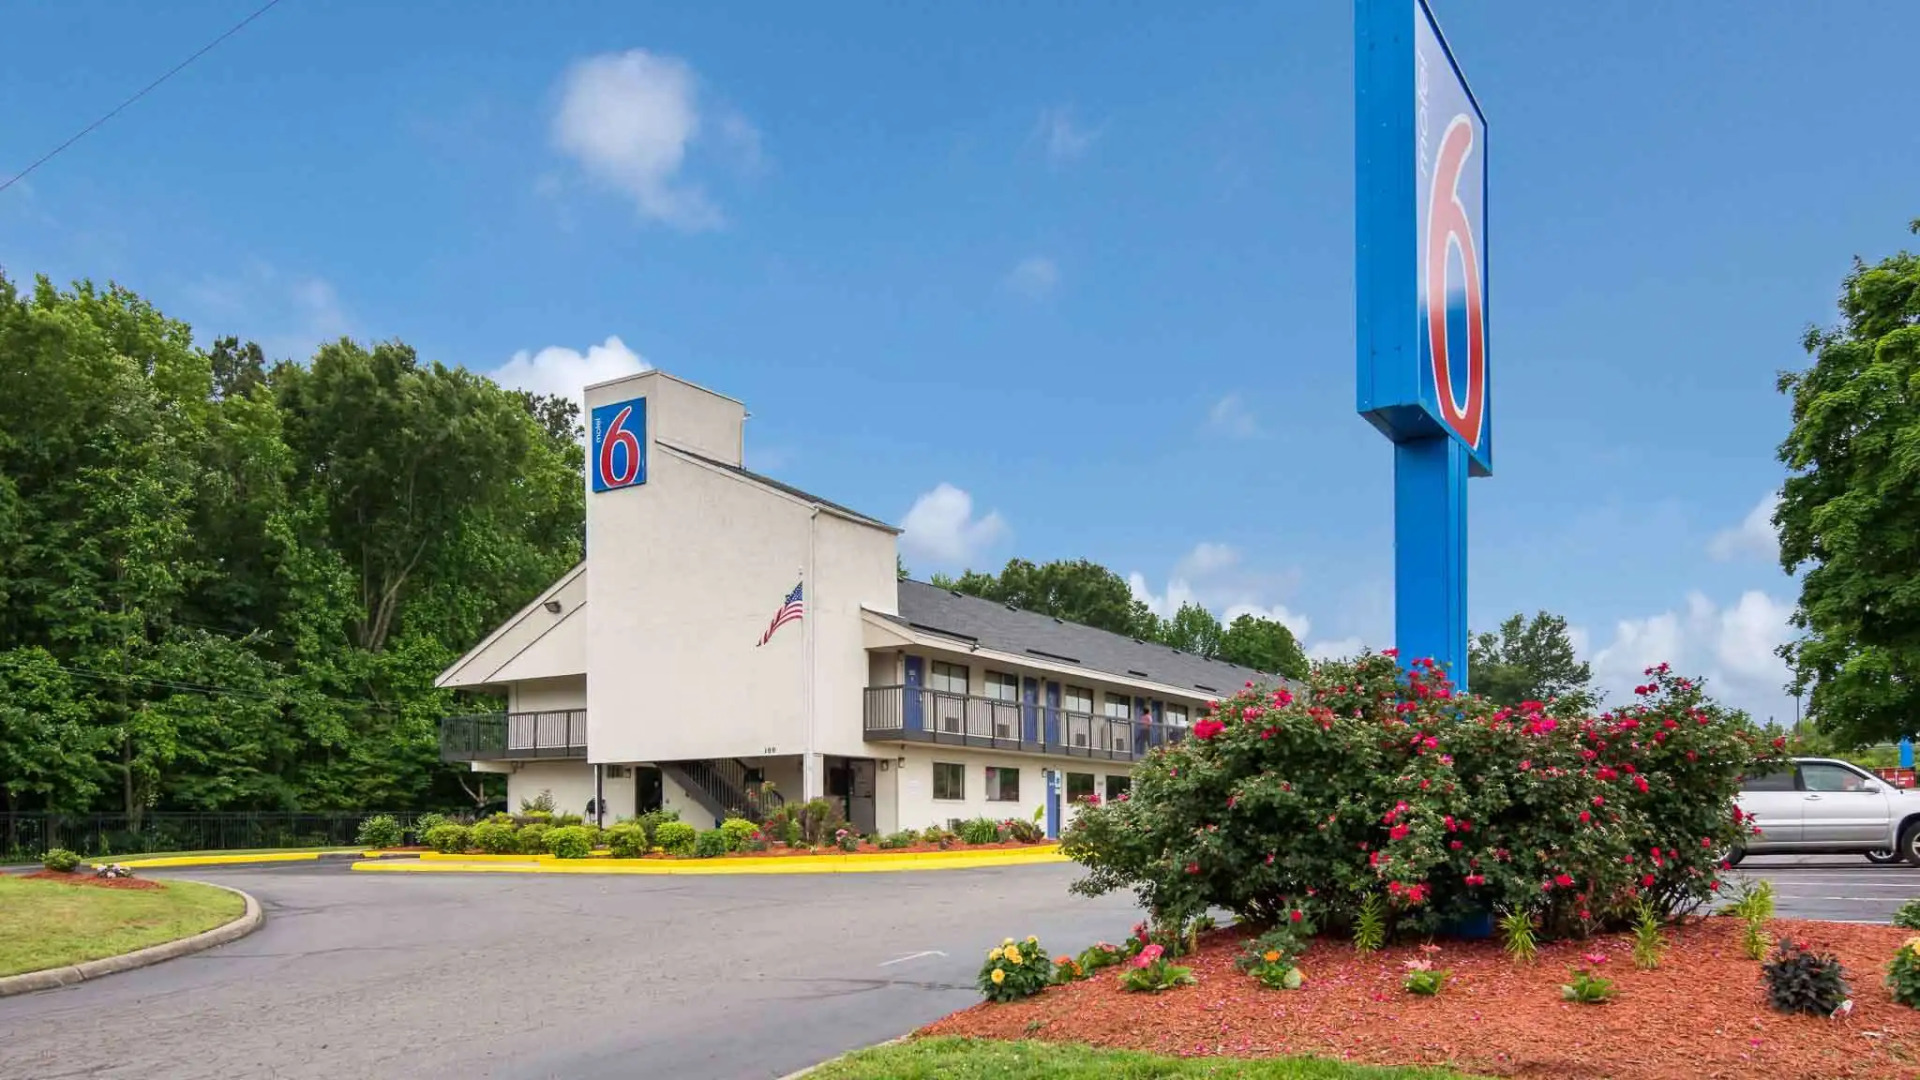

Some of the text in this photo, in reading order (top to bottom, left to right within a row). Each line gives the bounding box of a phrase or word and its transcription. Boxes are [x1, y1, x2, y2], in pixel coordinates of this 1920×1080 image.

[1417, 47, 1429, 178] motel
[1427, 113, 1486, 452] 6
[600, 405, 640, 488] 6
